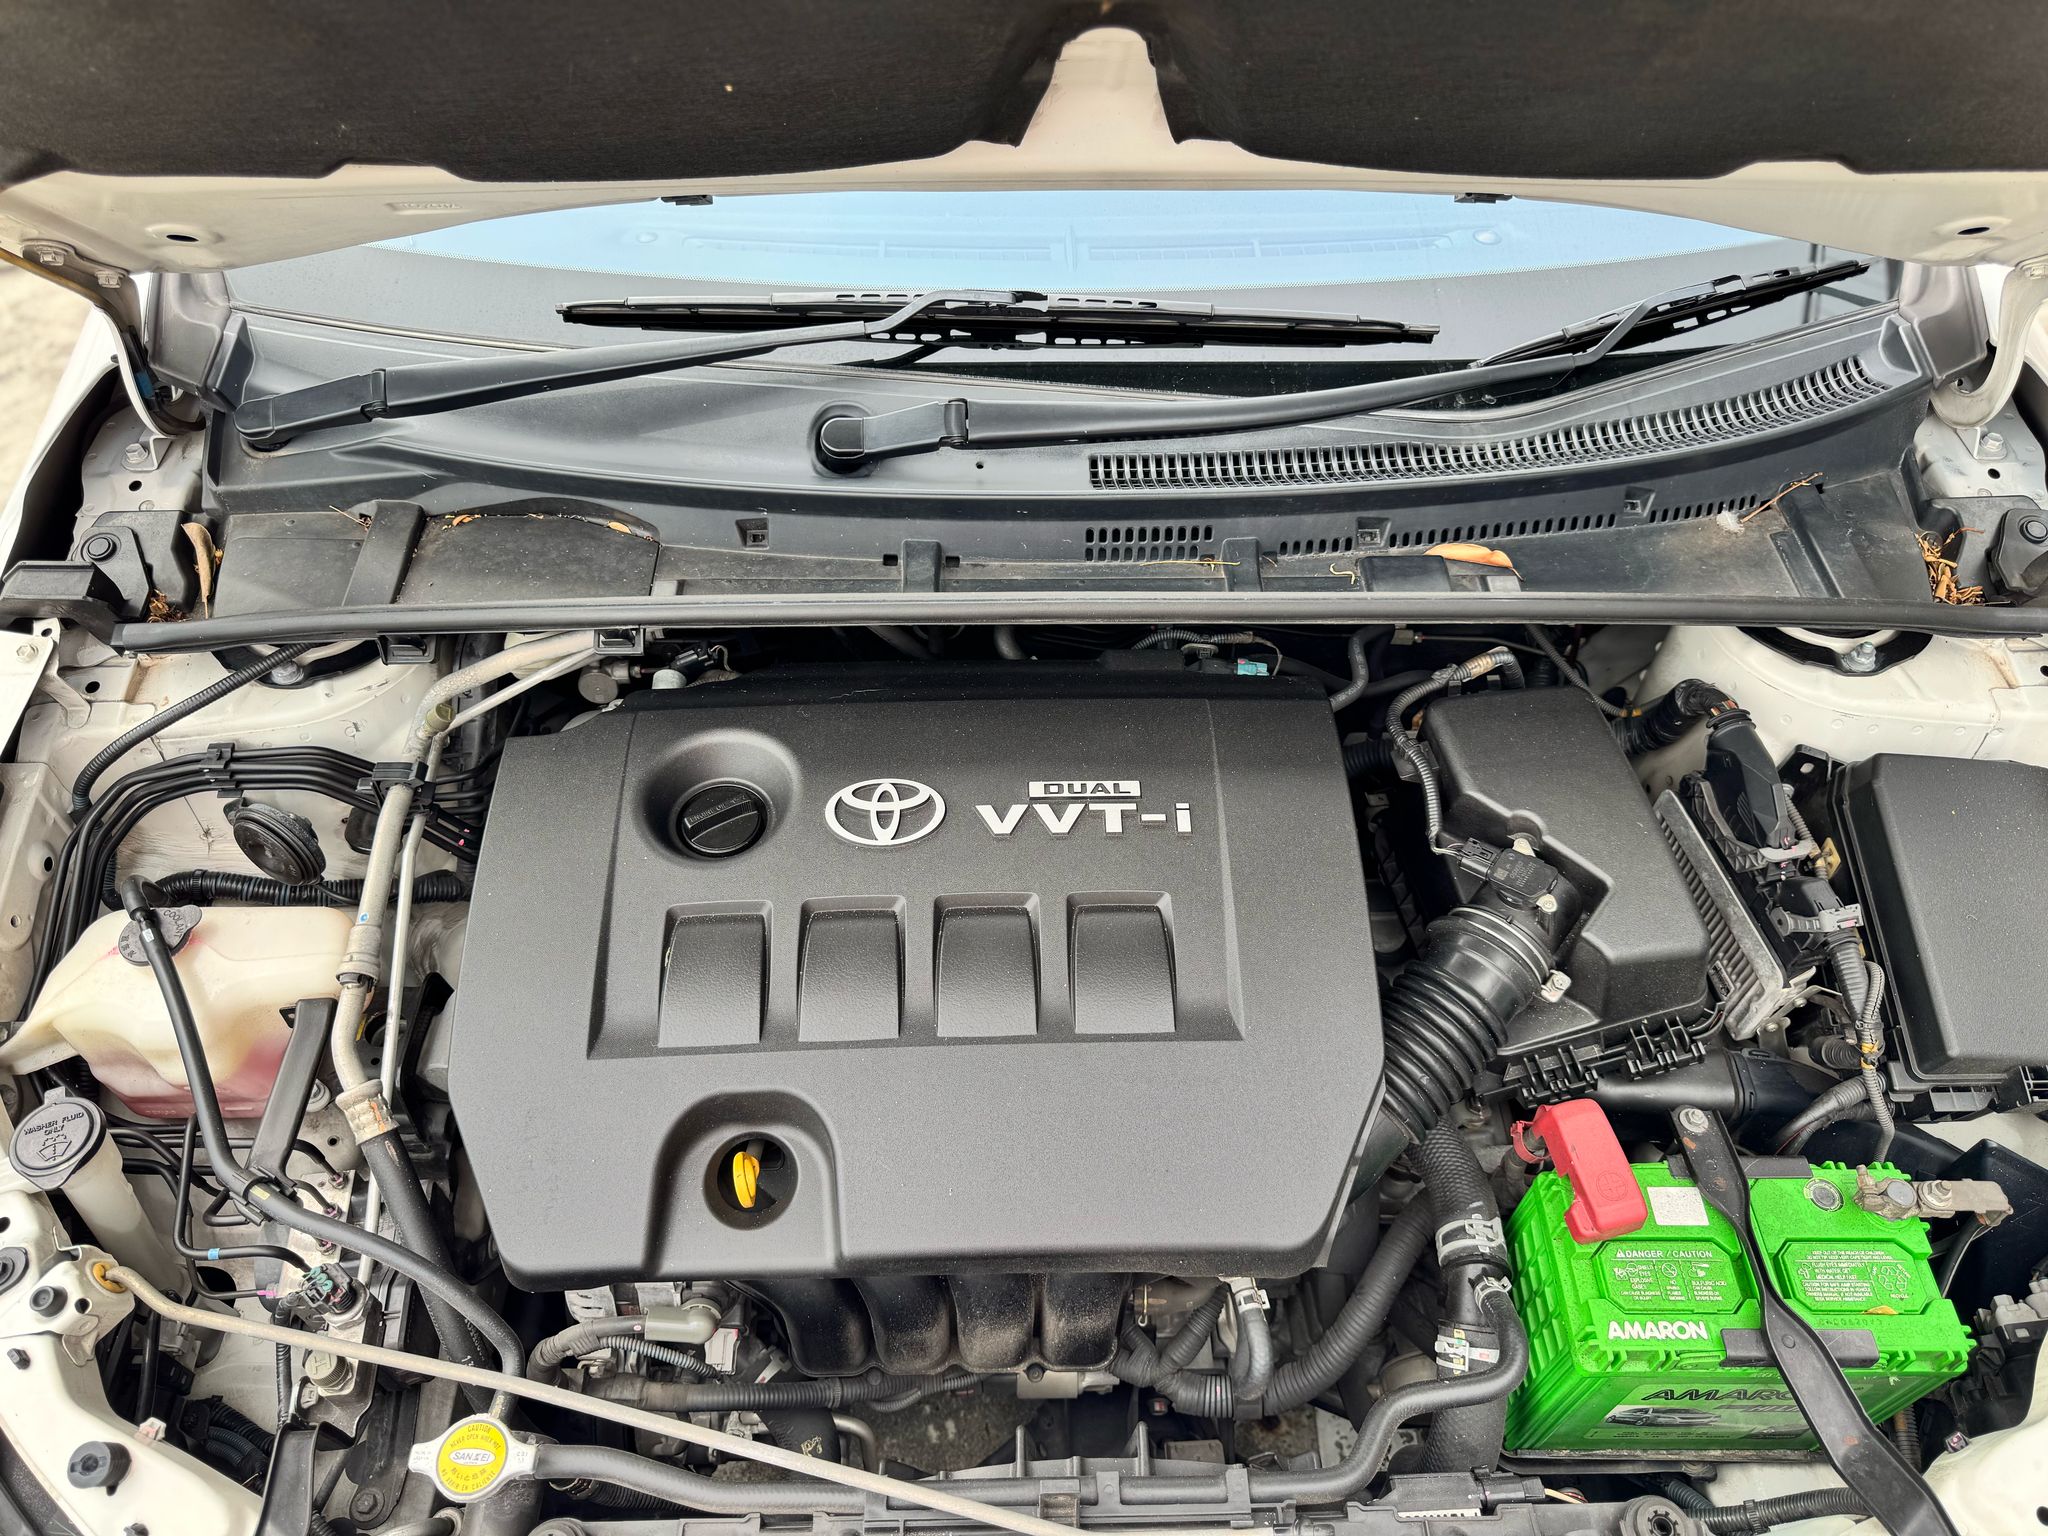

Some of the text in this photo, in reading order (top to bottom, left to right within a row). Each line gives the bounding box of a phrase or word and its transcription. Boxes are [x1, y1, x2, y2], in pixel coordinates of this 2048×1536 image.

[1043, 782, 1132, 795] DUAL
[975, 802, 1193, 836] VVT-i
[163, 909, 185, 939] COOLANT
[24, 1111, 85, 1136] WASHER FLUID
[44, 1124, 65, 1136] ONLY
[1626, 1250, 1664, 1258] DANGER
[1672, 1250, 1713, 1258] CAUTION
[1608, 1320, 1709, 1340] AMARON
[1640, 1388, 1798, 1401] AMARO
[467, 1423, 492, 1434] CAUTION
